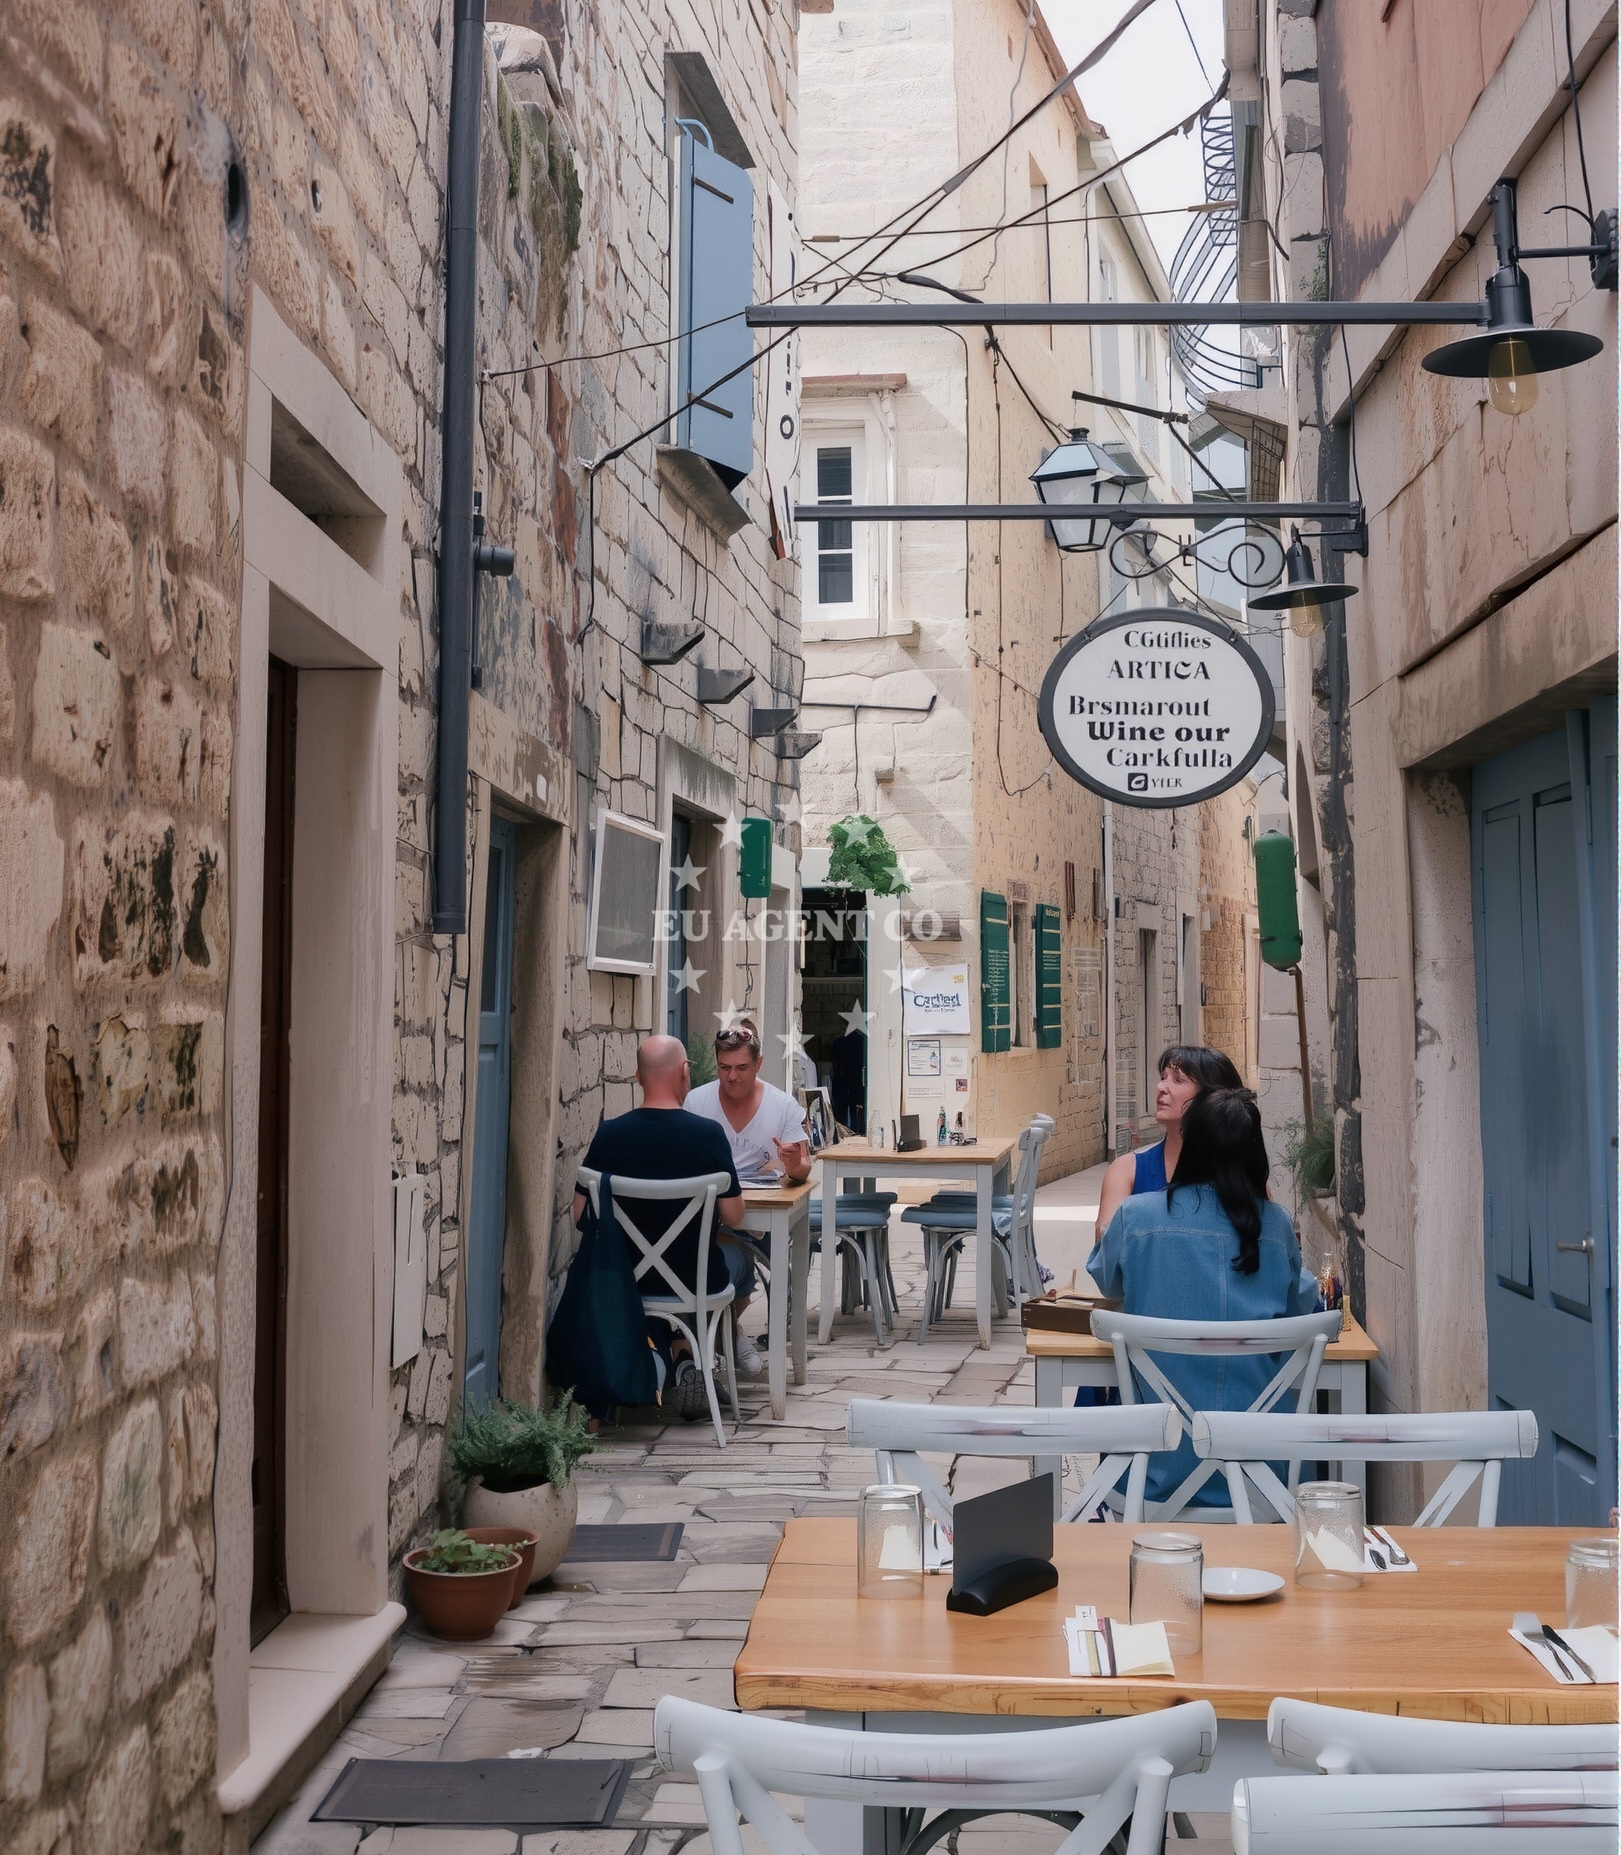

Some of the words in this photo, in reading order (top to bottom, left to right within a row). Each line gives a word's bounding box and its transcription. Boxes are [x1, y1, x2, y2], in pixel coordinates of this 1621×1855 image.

[1108, 659, 1211, 680] ARTICA
[1069, 695, 1212, 717] Brsmarout
[1087, 720, 1165, 741] Wine
[1174, 726, 1230, 742] our
[1106, 747, 1232, 768] Carkfulla
